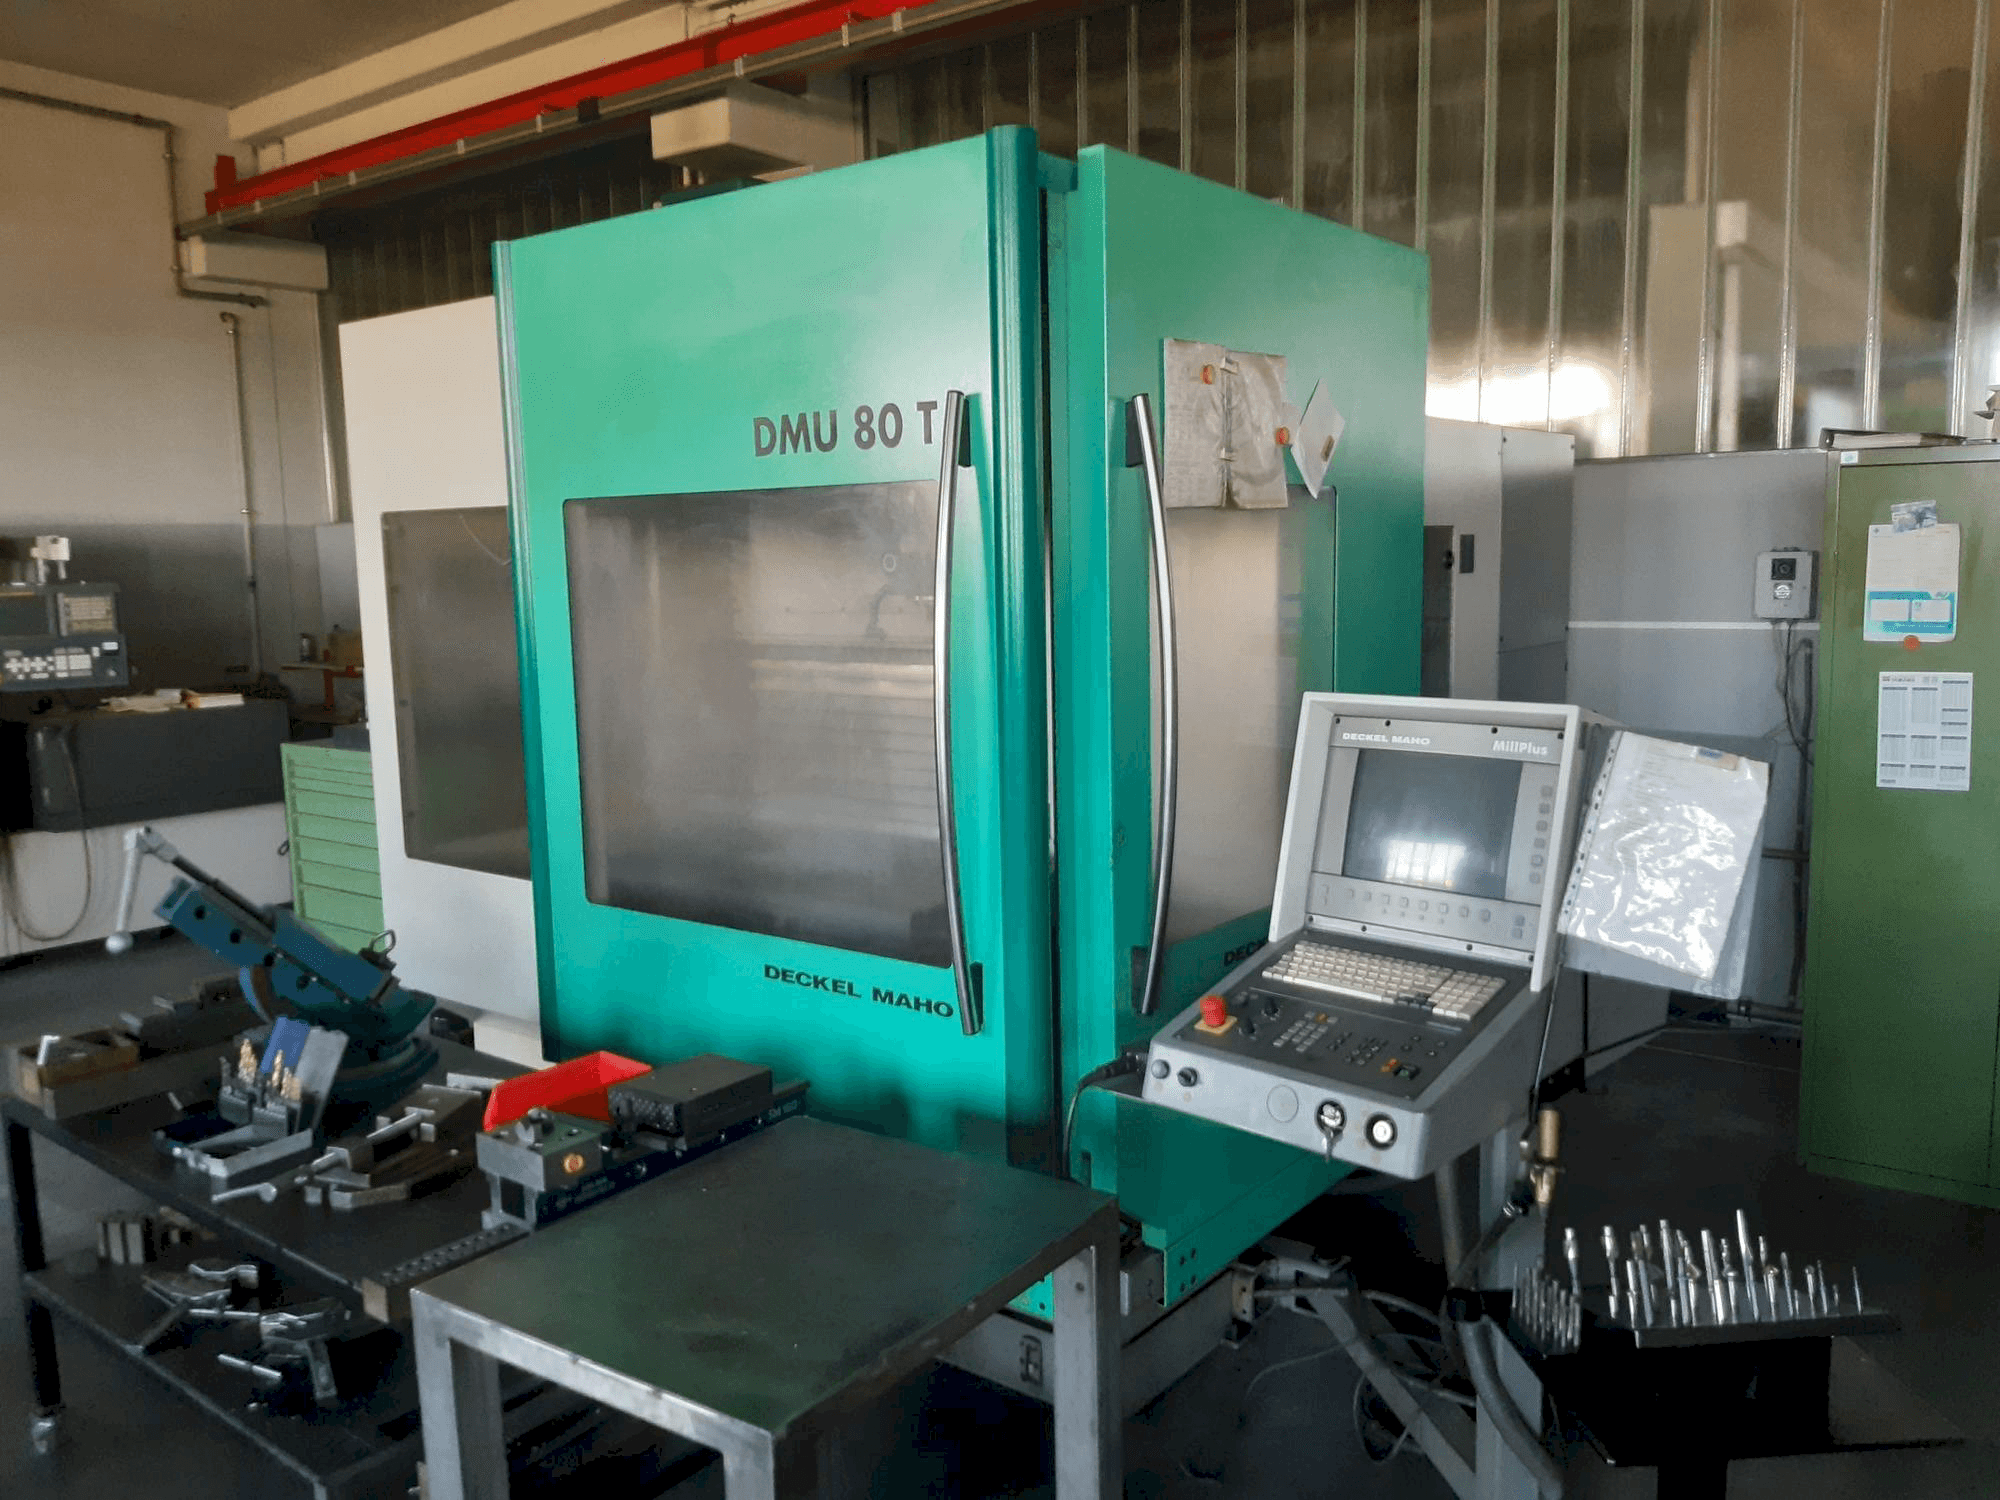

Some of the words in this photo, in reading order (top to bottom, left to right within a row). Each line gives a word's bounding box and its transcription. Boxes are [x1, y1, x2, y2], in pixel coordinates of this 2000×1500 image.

[753, 409, 837, 457] DMU
[854, 402, 903, 450] 80
[916, 400, 938, 445] T
[1342, 732, 1389, 743] DECKEL
[1391, 735, 1431, 745] MAHO
[1492, 740, 1548, 756] MillPlus
[764, 963, 862, 998] DECKEL
[872, 986, 954, 1018] MAHO
